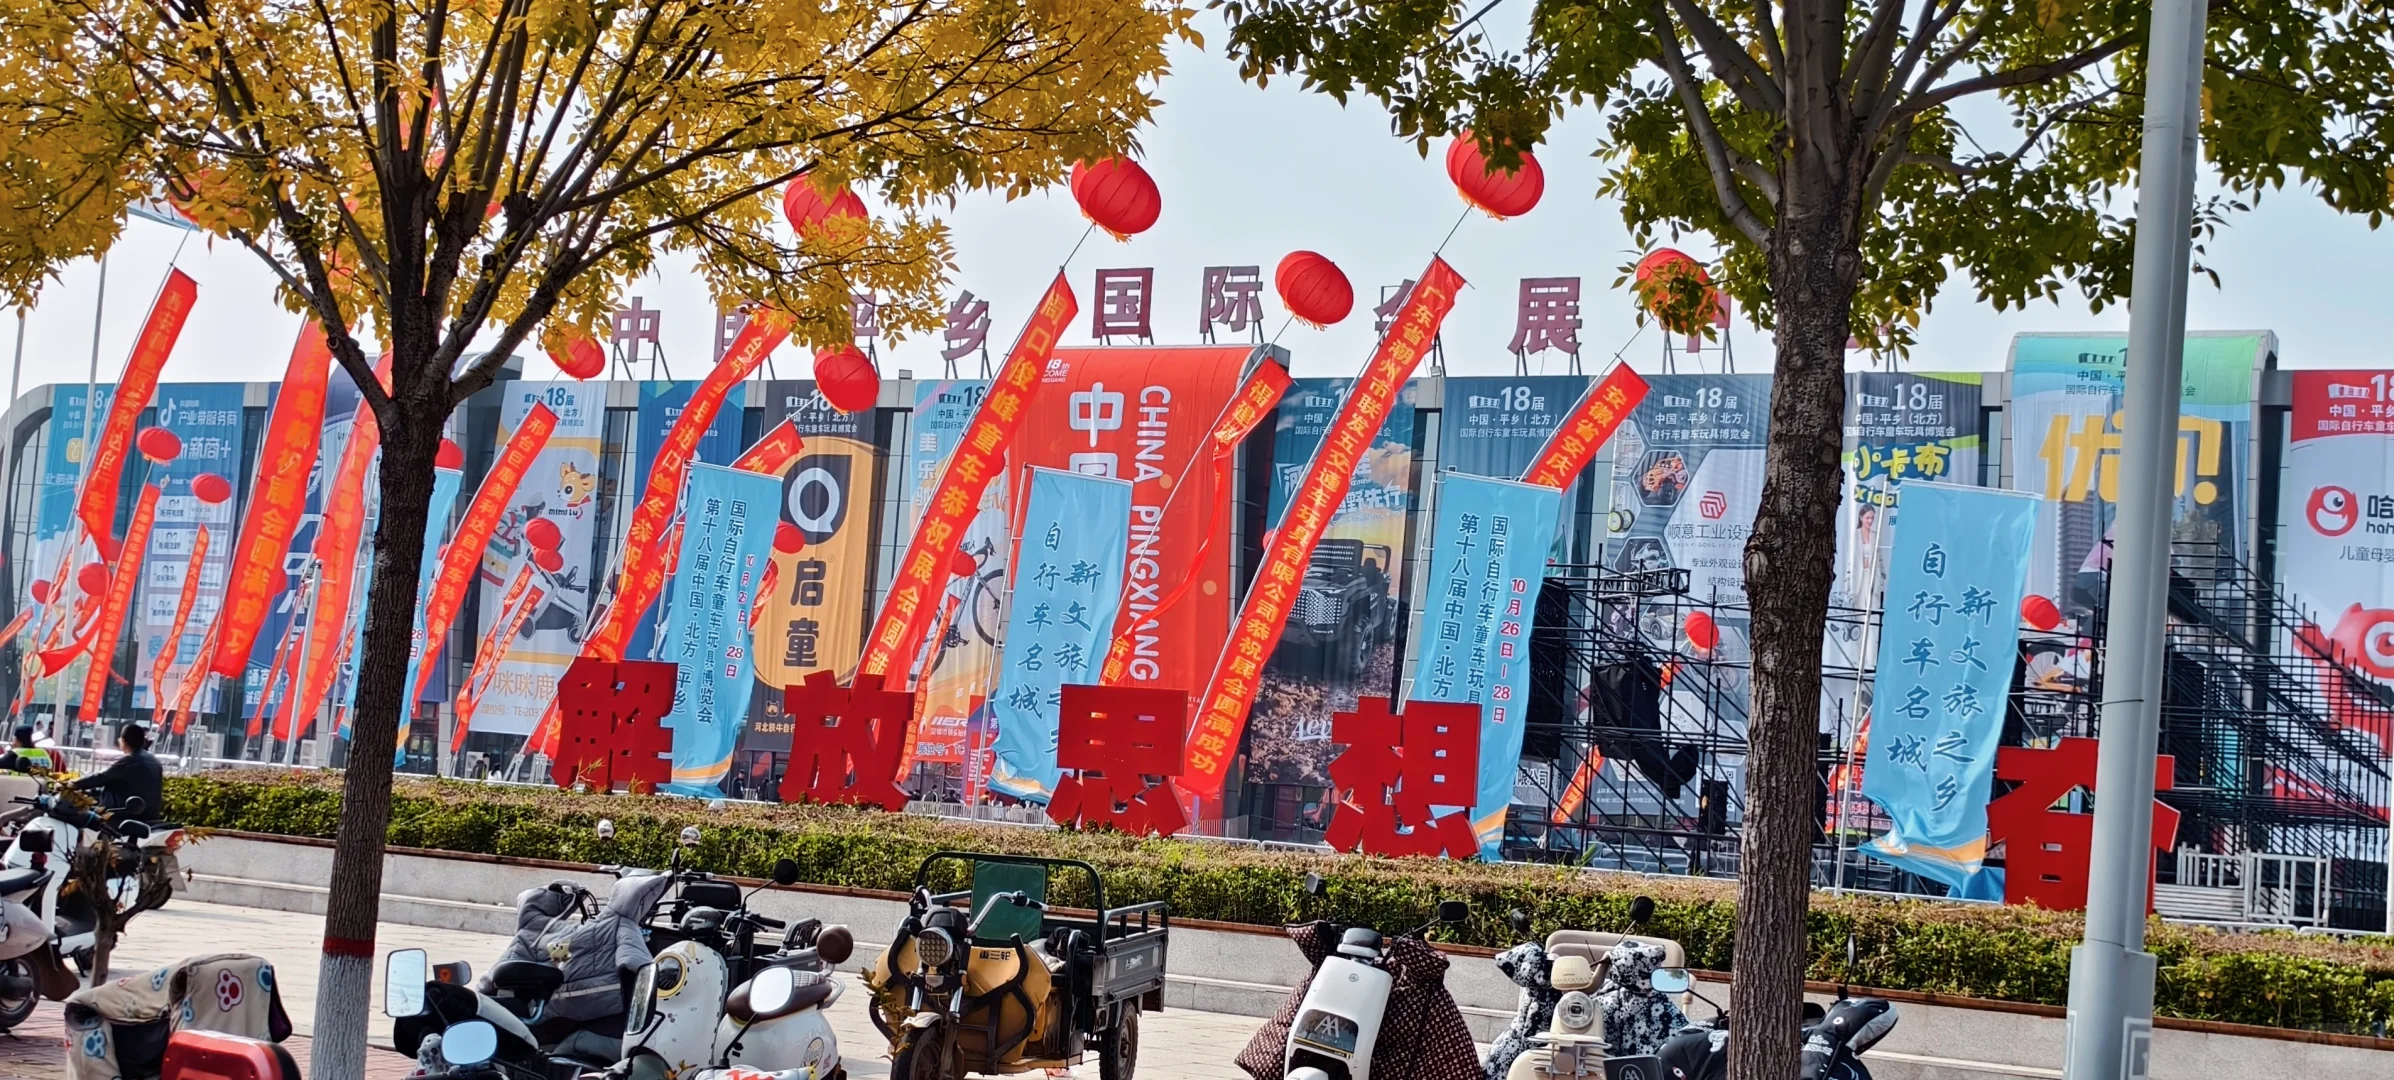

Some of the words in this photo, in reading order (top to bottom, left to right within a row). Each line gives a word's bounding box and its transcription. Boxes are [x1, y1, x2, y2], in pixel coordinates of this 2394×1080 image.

[1133, 384, 1172, 483] CHINA
[1500, 385, 1545, 411] 18届
[1695, 387, 1738, 409] 18届
[1892, 383, 1943, 411] 18届
[696, 499, 748, 725] 国际自行车童车玩具博览会
[783, 556, 827, 668] 启童
[1007, 520, 1062, 720] 自行车名城
[1885, 542, 1951, 773] 自行车名城
[493, 670, 557, 701] 咪咪鹿
[1930, 585, 1998, 813] 新文旅之乡
